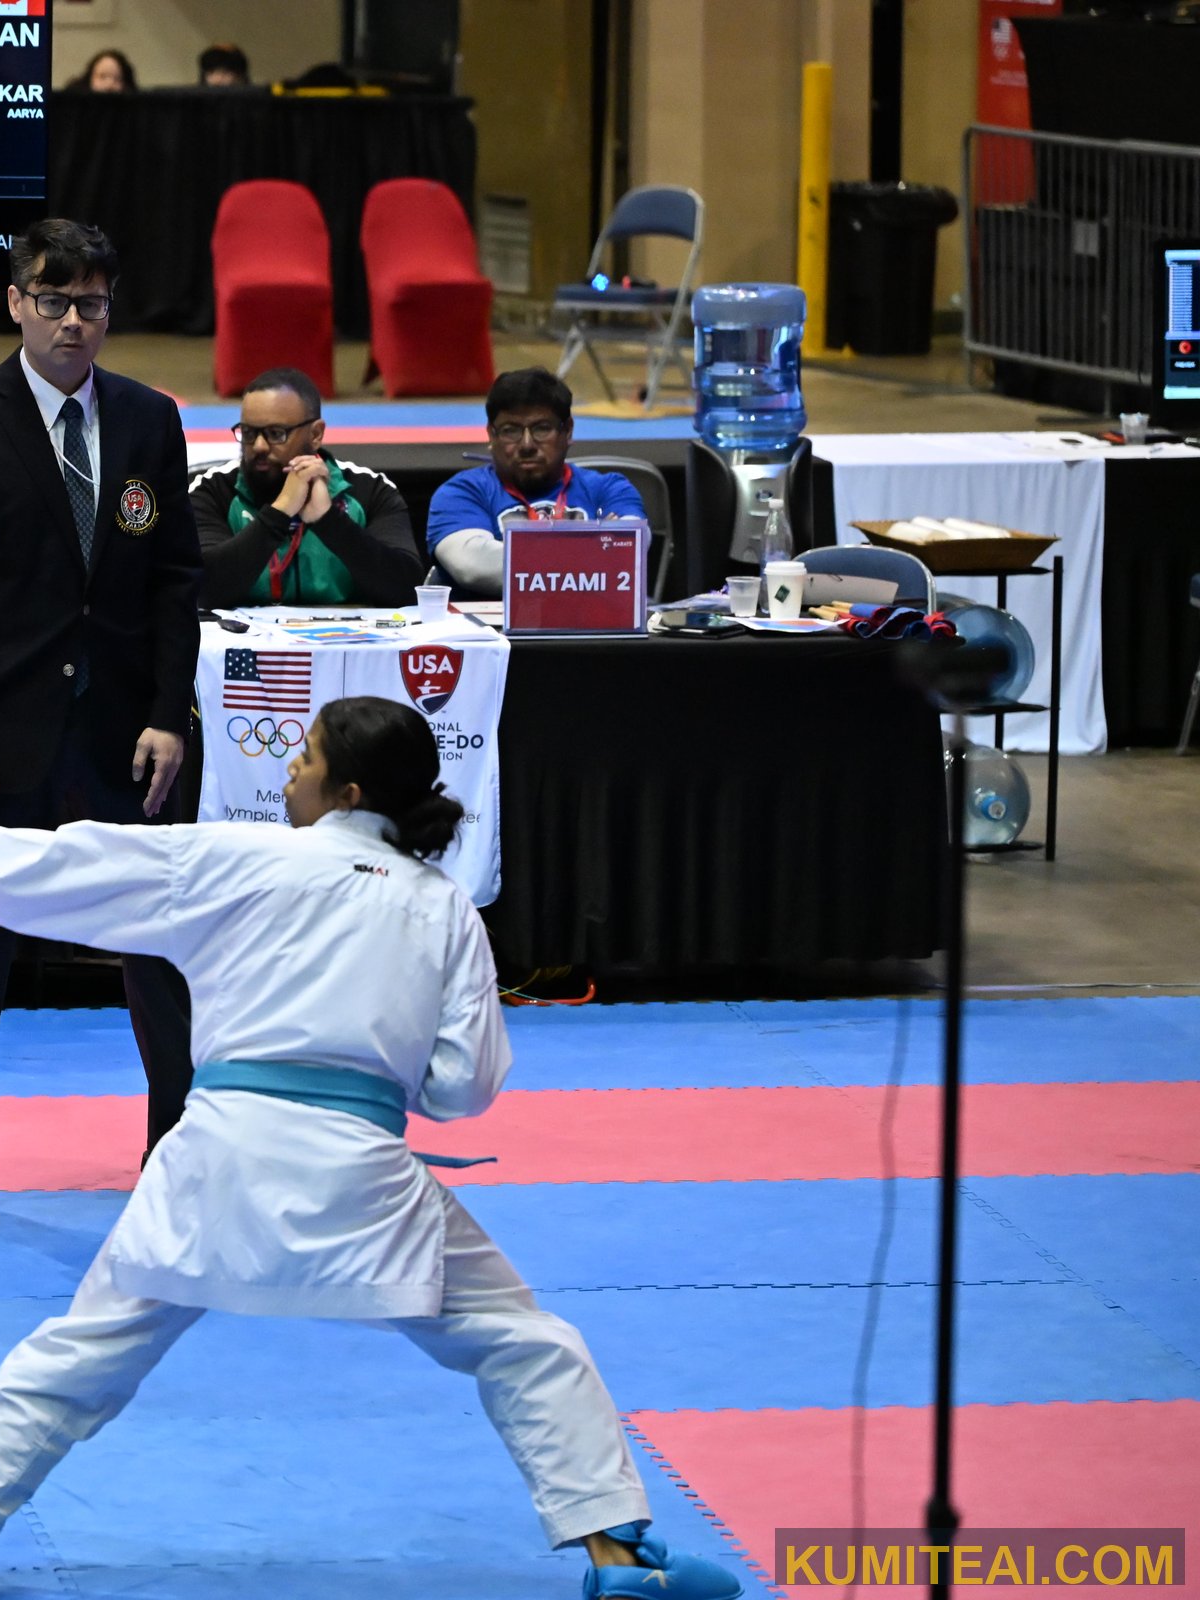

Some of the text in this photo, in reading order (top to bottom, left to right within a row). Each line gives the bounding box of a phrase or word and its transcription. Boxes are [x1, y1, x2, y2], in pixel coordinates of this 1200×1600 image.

[7, 108, 43, 119] AARYA
[515, 571, 631, 592] TATAMI 2
[408, 654, 454, 674] USA
[426, 722, 462, 732] ONAL
[225, 806, 278, 822] lympic
